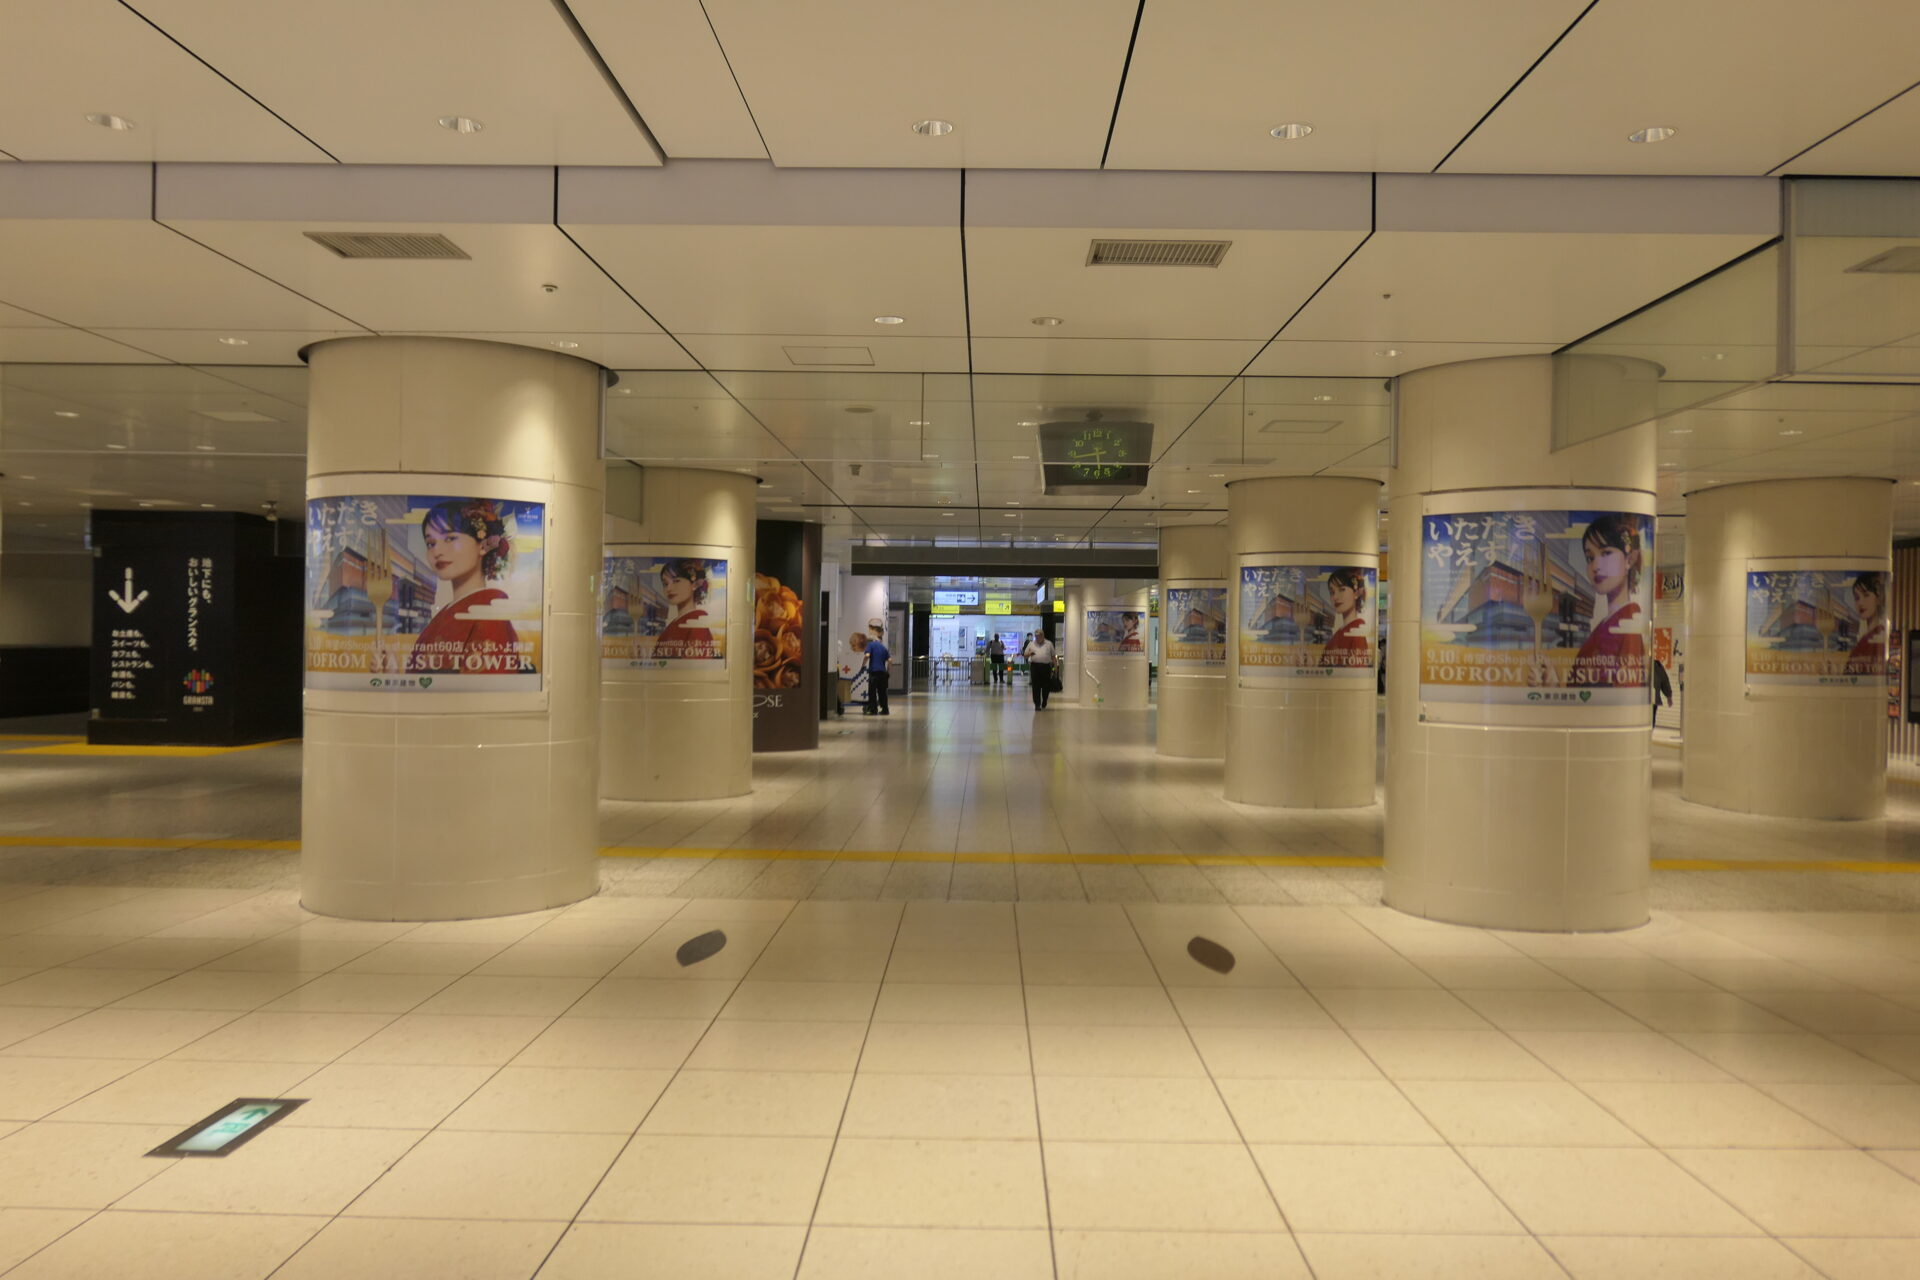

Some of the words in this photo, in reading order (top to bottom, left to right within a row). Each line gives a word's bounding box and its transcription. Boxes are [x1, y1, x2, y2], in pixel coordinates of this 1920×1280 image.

[1428, 514, 1537, 540] いただき
[449, 653, 534, 670] TOWER
[1426, 665, 1523, 682] TOFROM
[1530, 666, 1601, 683] YAESU
